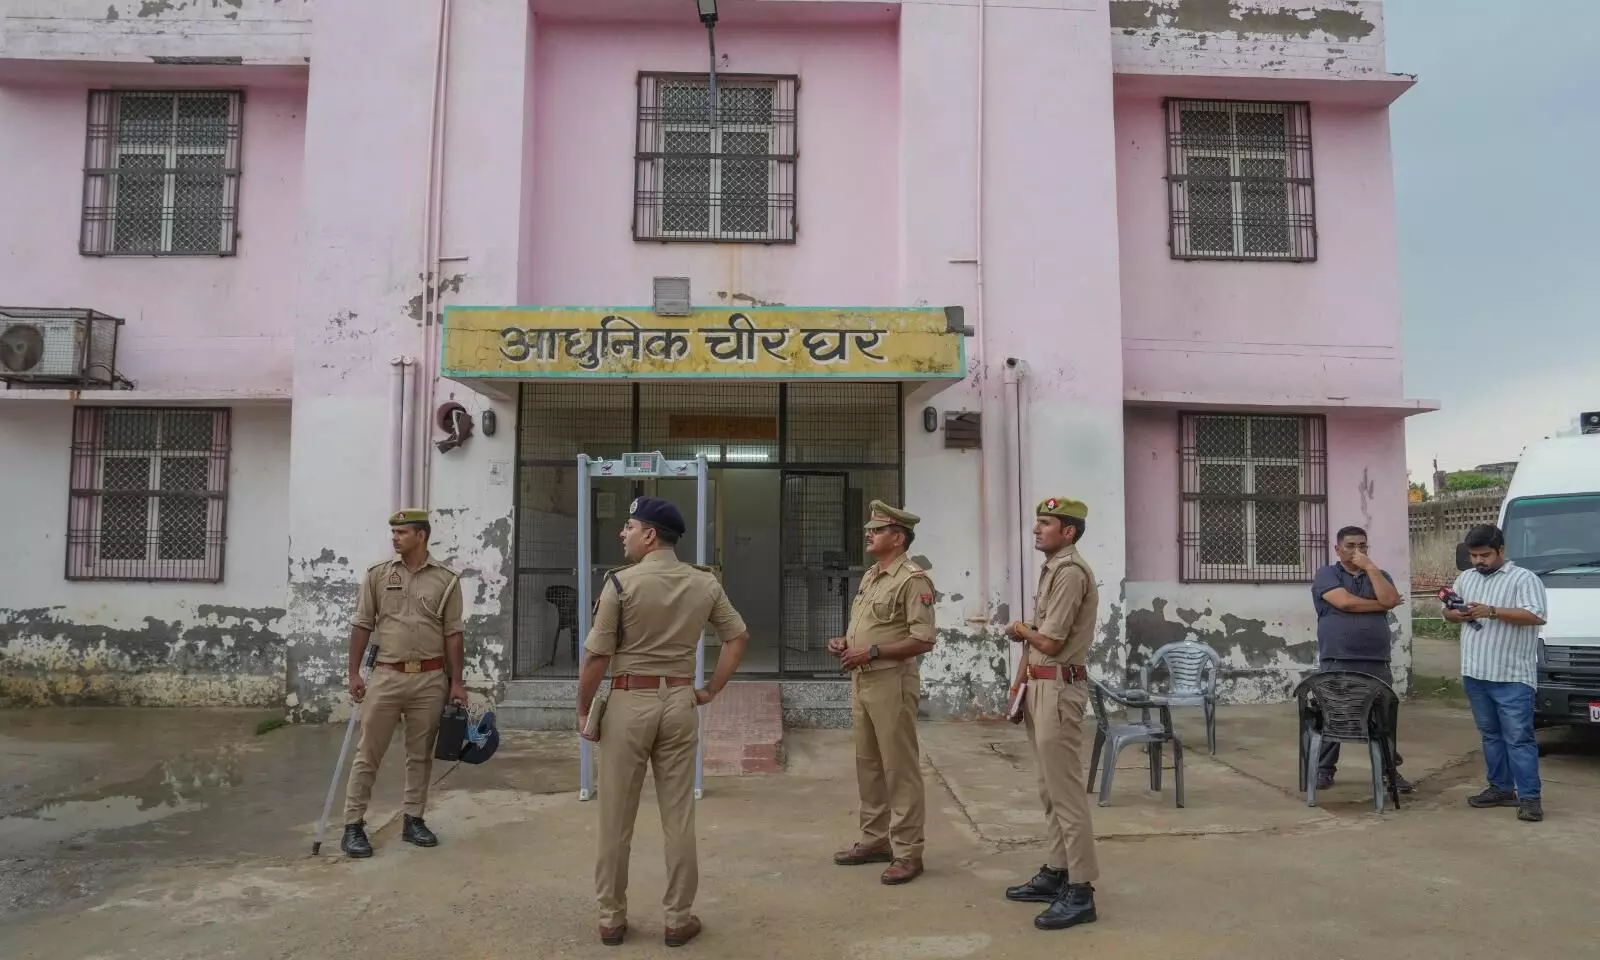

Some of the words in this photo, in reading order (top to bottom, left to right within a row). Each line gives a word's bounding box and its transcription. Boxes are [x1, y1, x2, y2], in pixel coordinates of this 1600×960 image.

[499, 315, 691, 370] आधुनिक
[697, 312, 791, 362] चीर
[799, 328, 889, 363] घर
